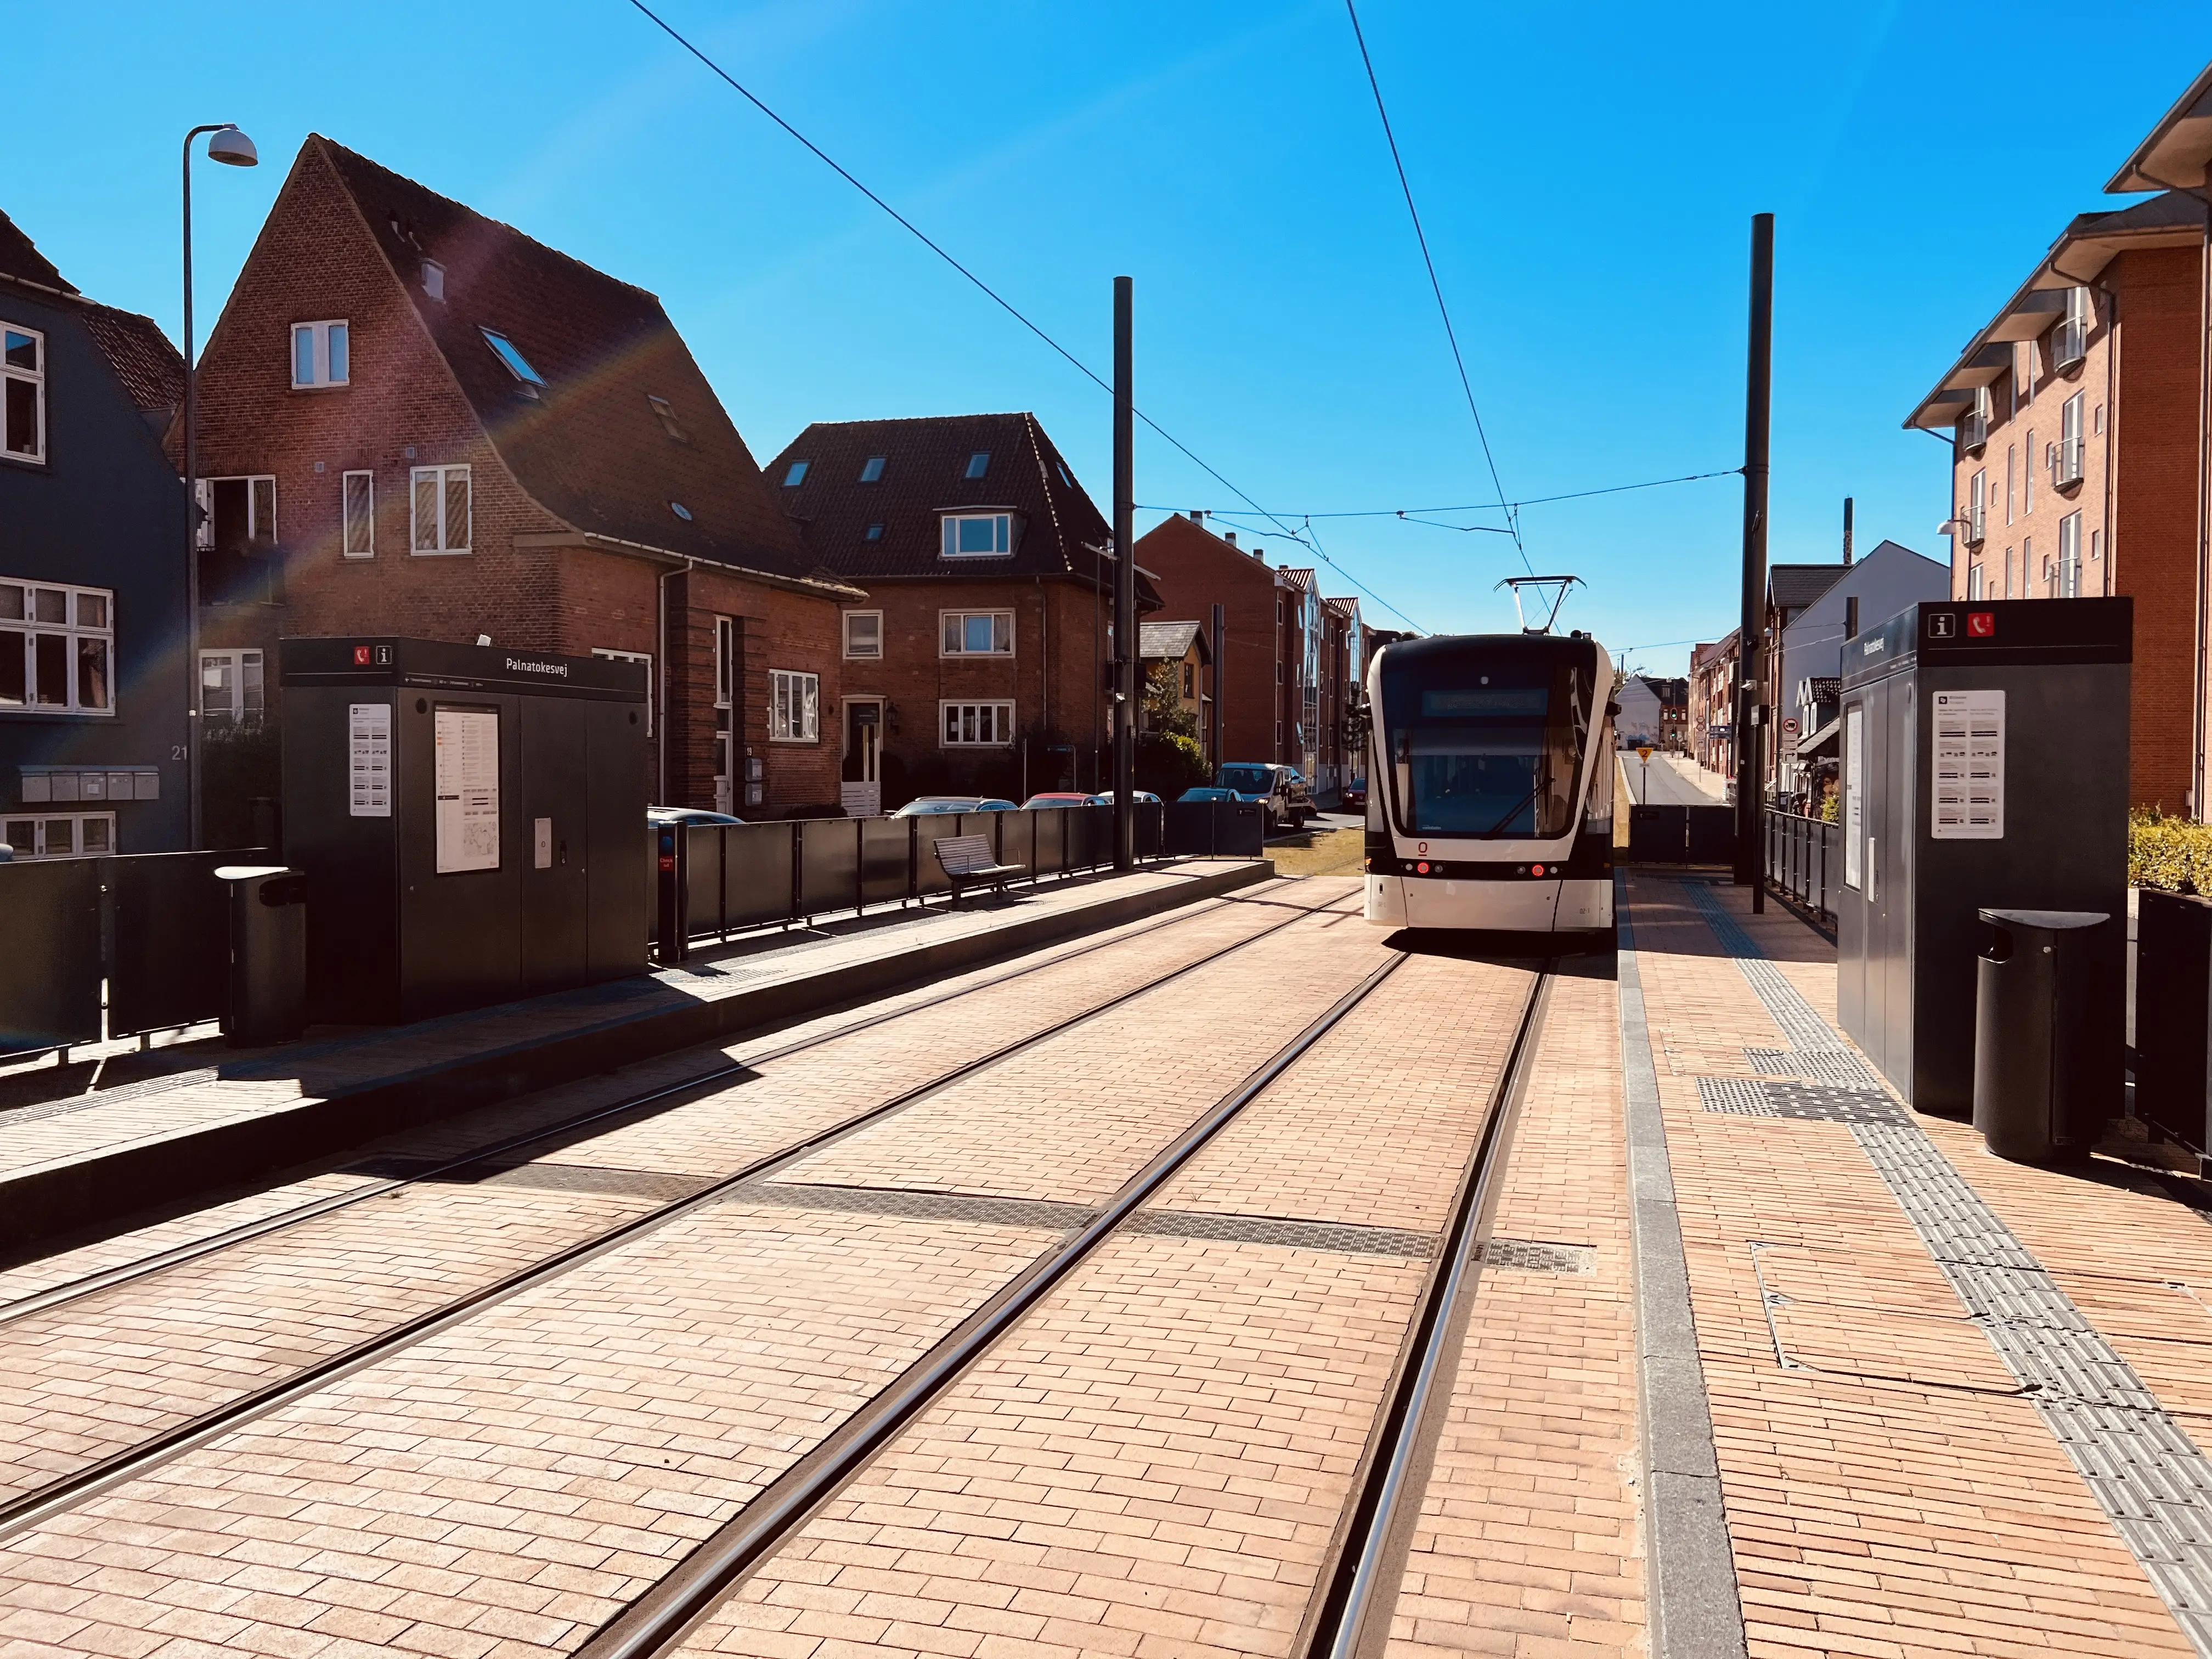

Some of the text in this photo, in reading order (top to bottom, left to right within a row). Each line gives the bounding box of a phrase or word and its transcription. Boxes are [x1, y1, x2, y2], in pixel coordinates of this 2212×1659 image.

[506, 658, 568, 678] Palnatokesvej
[171, 744, 187, 760] 21
[1642, 749, 1648, 758] 2
